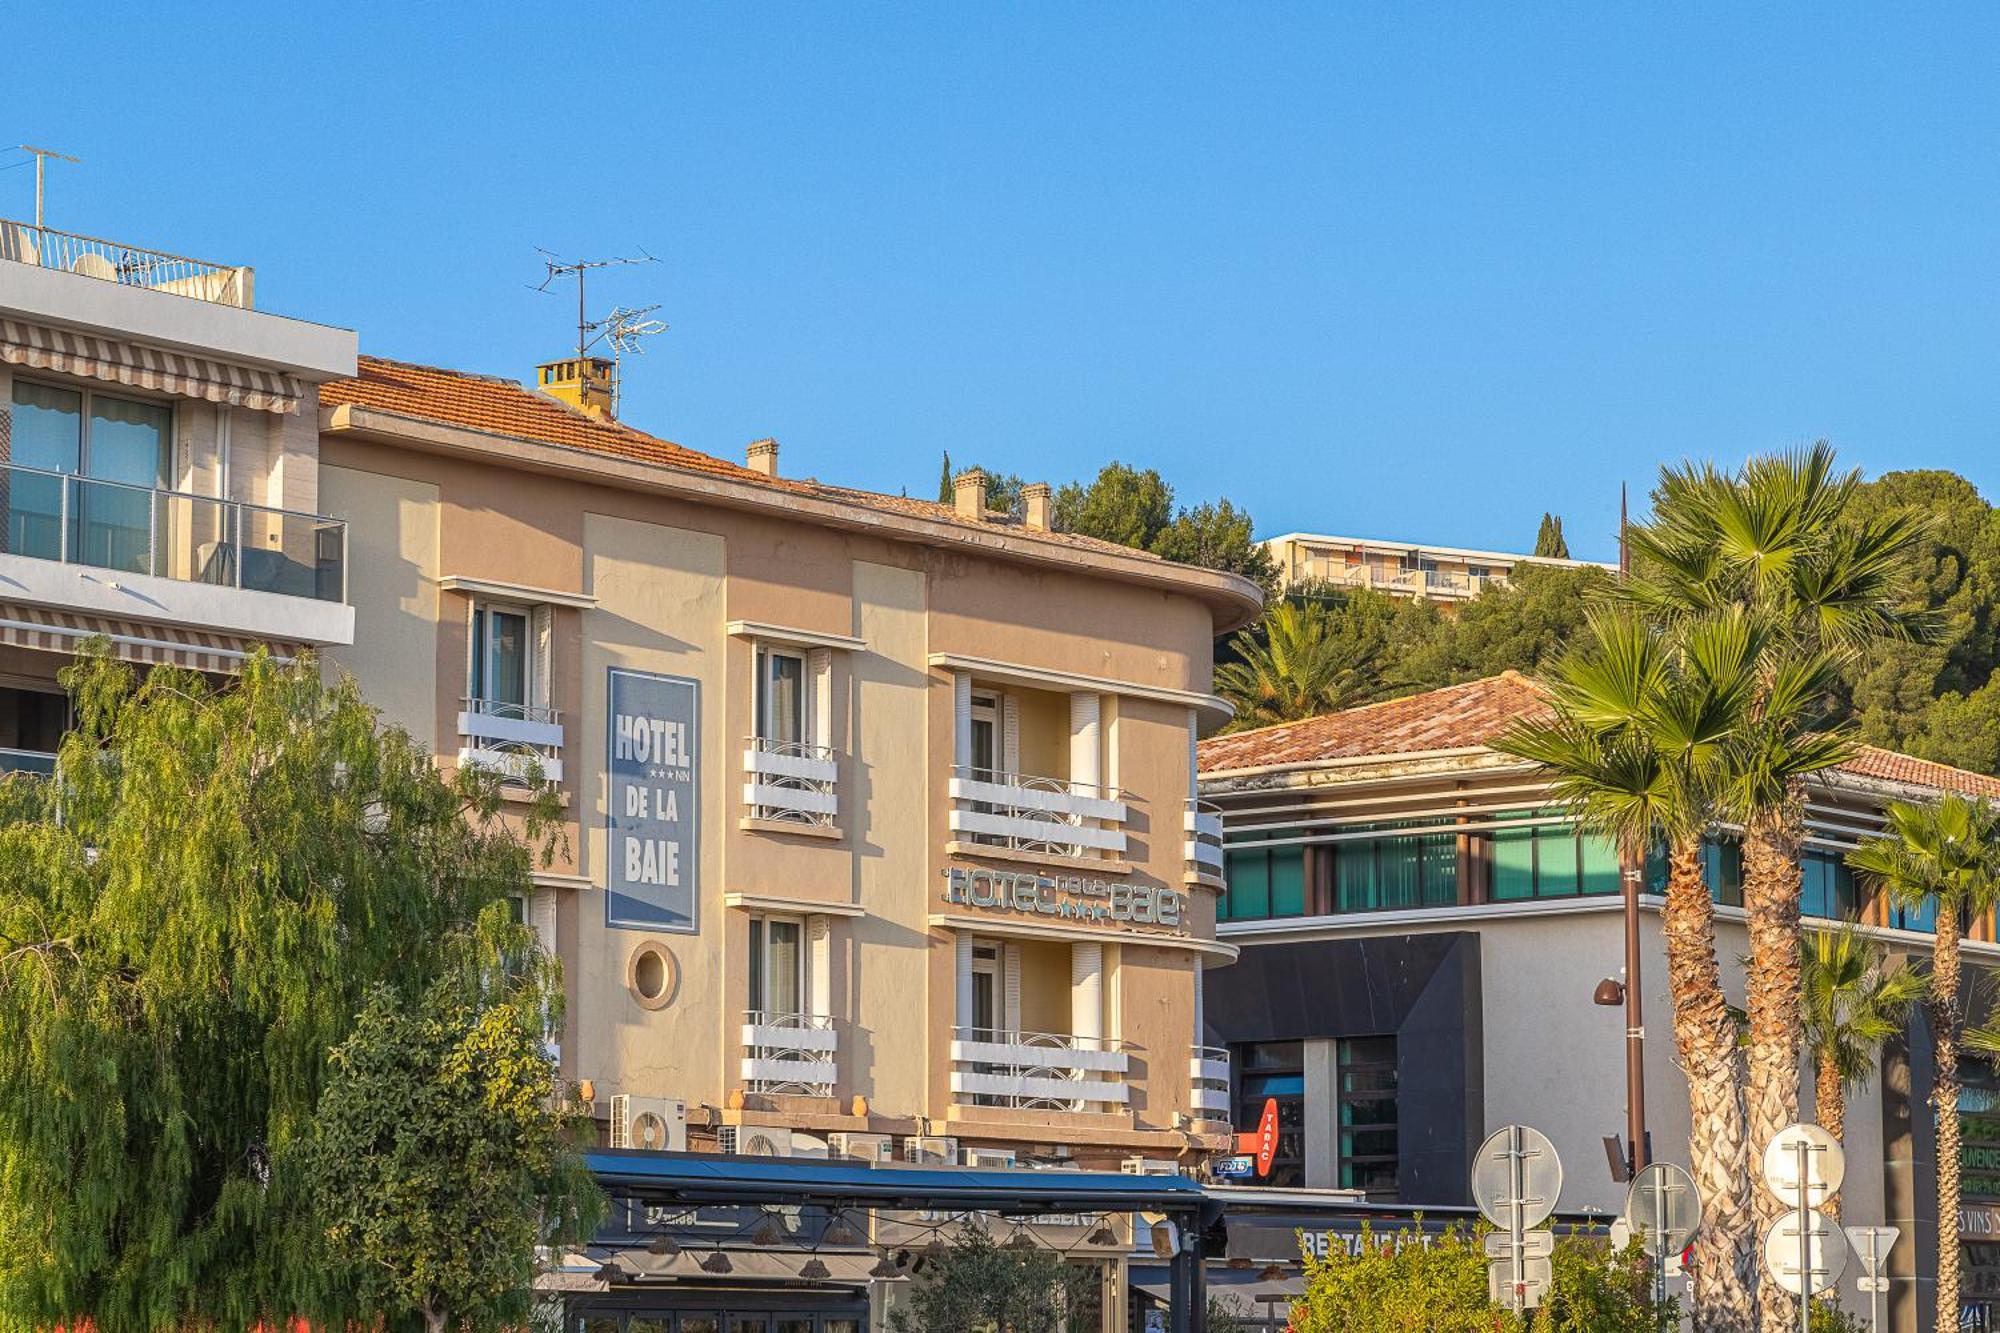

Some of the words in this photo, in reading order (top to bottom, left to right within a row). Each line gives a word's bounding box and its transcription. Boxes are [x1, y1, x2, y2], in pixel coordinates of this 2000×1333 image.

[615, 714, 690, 768] HOTEL
[626, 785, 648, 818] DE
[656, 788, 678, 823] LA
[625, 836, 679, 886] BAIE
[1261, 1113, 1274, 1161] TABAC
[1967, 1211, 1992, 1233] VINS
